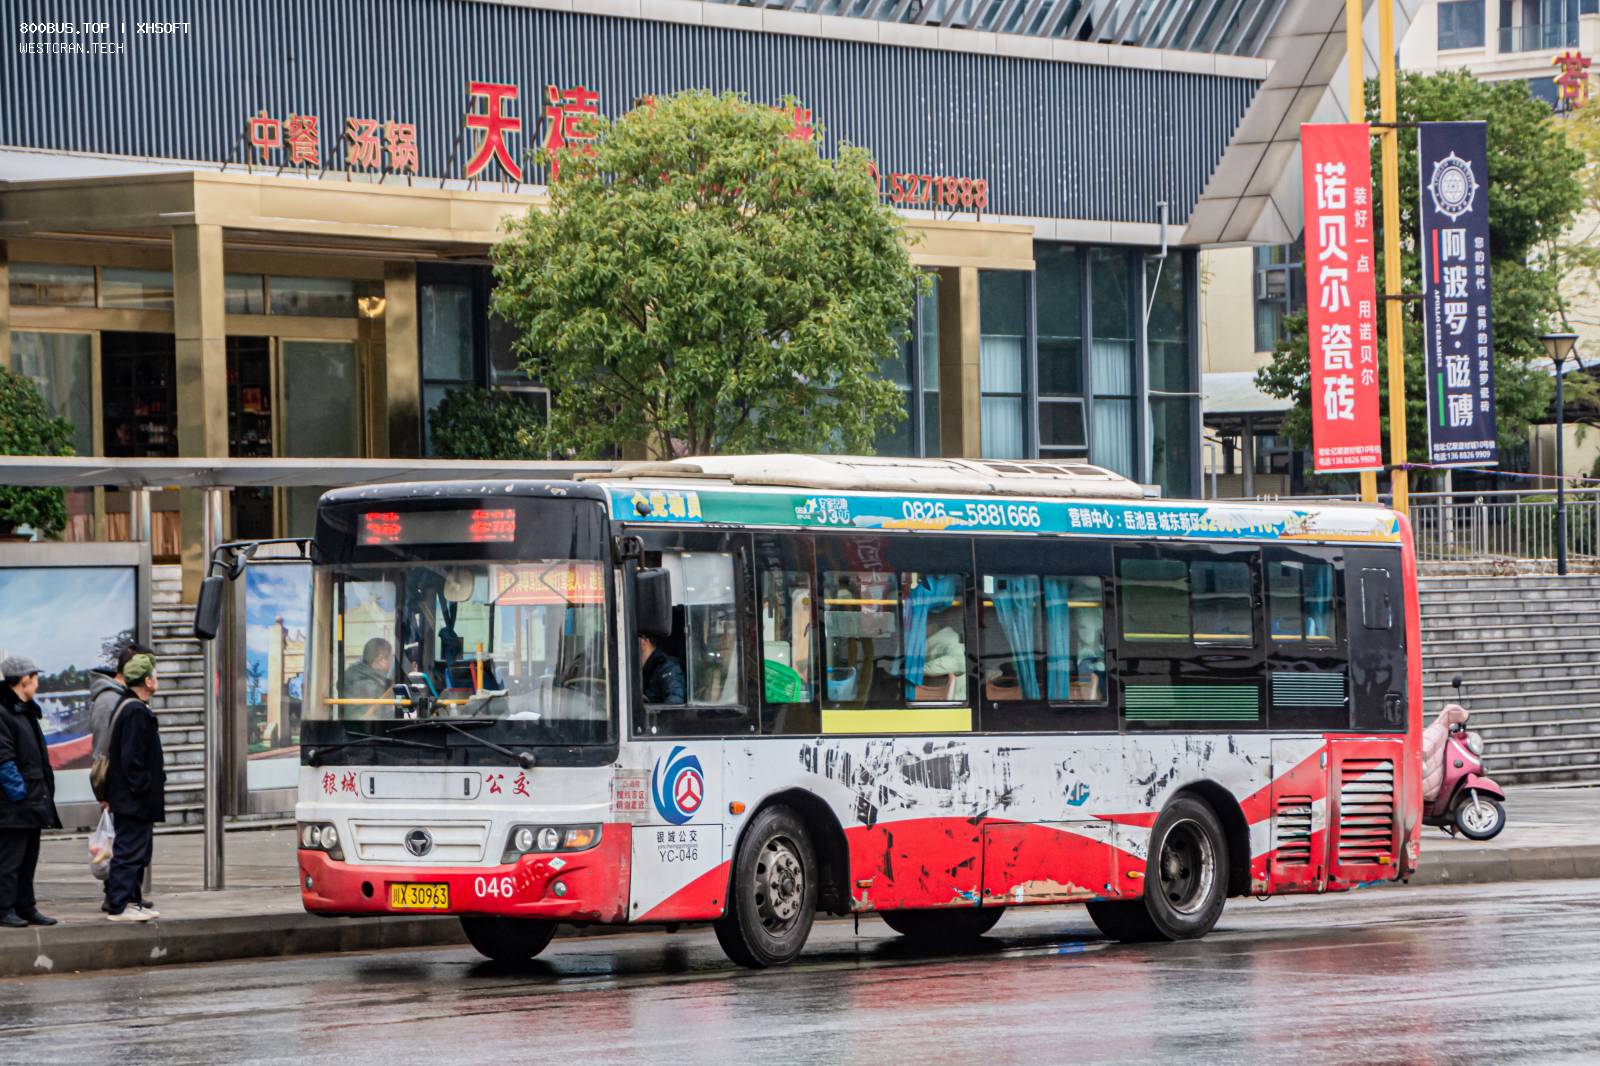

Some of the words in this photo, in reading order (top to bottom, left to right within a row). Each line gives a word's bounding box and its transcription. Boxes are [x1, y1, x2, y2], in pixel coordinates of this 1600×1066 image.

[248, 110, 320, 165] 中餐
[346, 117, 418, 174] 汤锅
[1353, 186, 1369, 273] 装好一点
[1314, 162, 1355, 422] 诺贝尔瓷砖
[1358, 299, 1374, 386] 用诺贝尔
[322, 771, 359, 797] 银城
[485, 771, 531, 798] 公交
[656, 830, 698, 843] 银城公交
[660, 848, 698, 862] YC-046
[474, 876, 514, 898] 046
